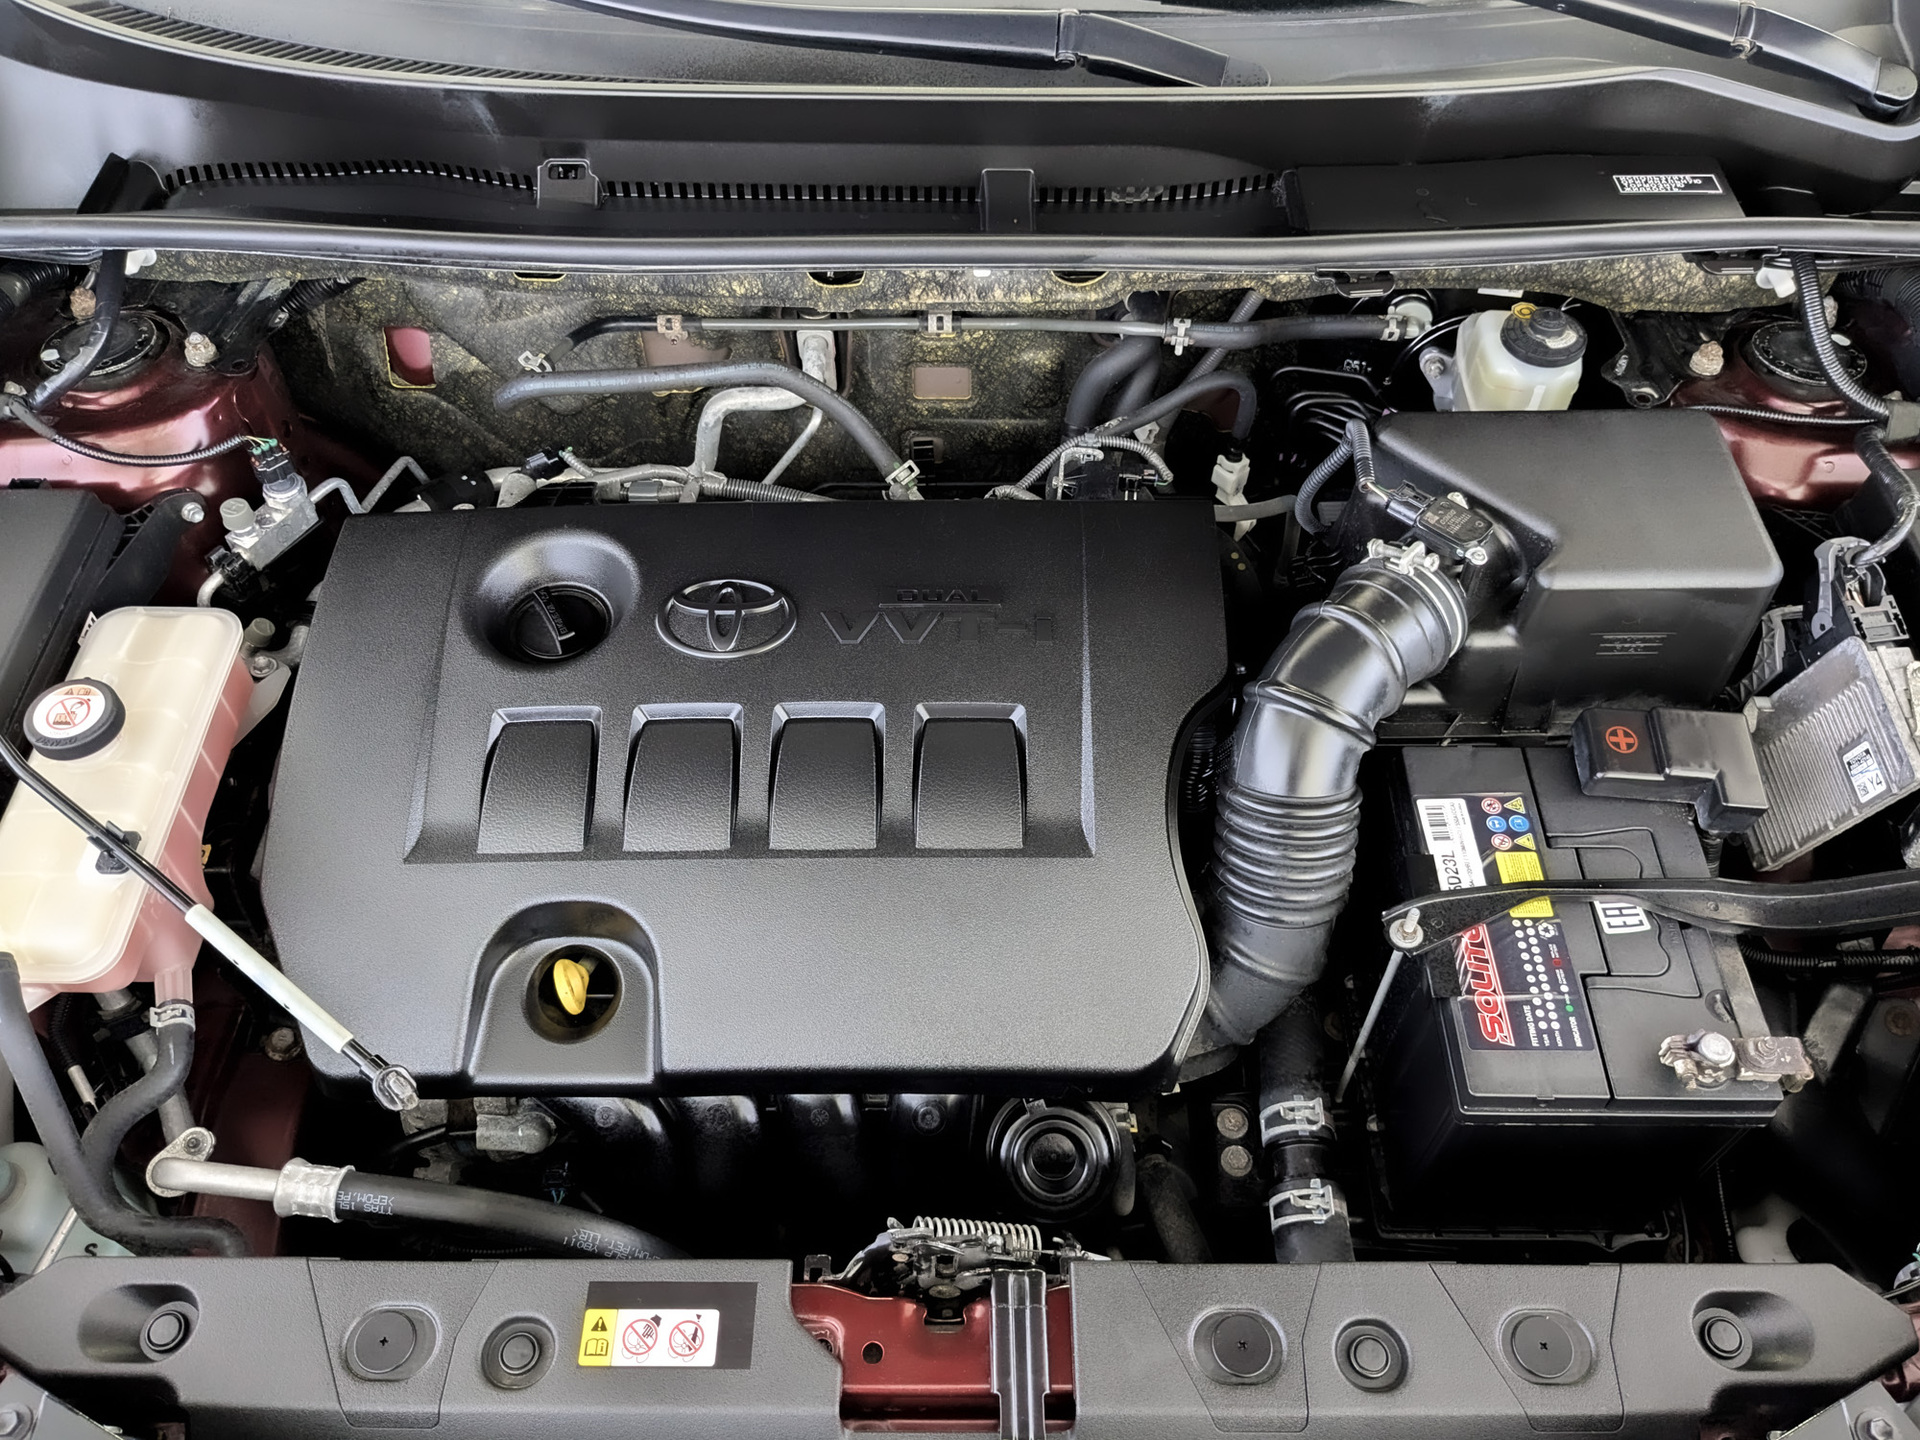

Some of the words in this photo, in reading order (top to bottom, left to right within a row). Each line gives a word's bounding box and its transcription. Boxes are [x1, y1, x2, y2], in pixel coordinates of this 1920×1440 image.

[896, 588, 989, 602] DUAL
[1867, 773, 1883, 791] Y4
[1600, 902, 1645, 929] EA
[1523, 1005, 1536, 1022] DATE
[1527, 1022, 1540, 1047] FITTING
[1554, 1030, 1563, 1047] MONTH
[1568, 1016, 1583, 1047] INDICATOR
[1542, 1034, 1550, 1047] YEAR
